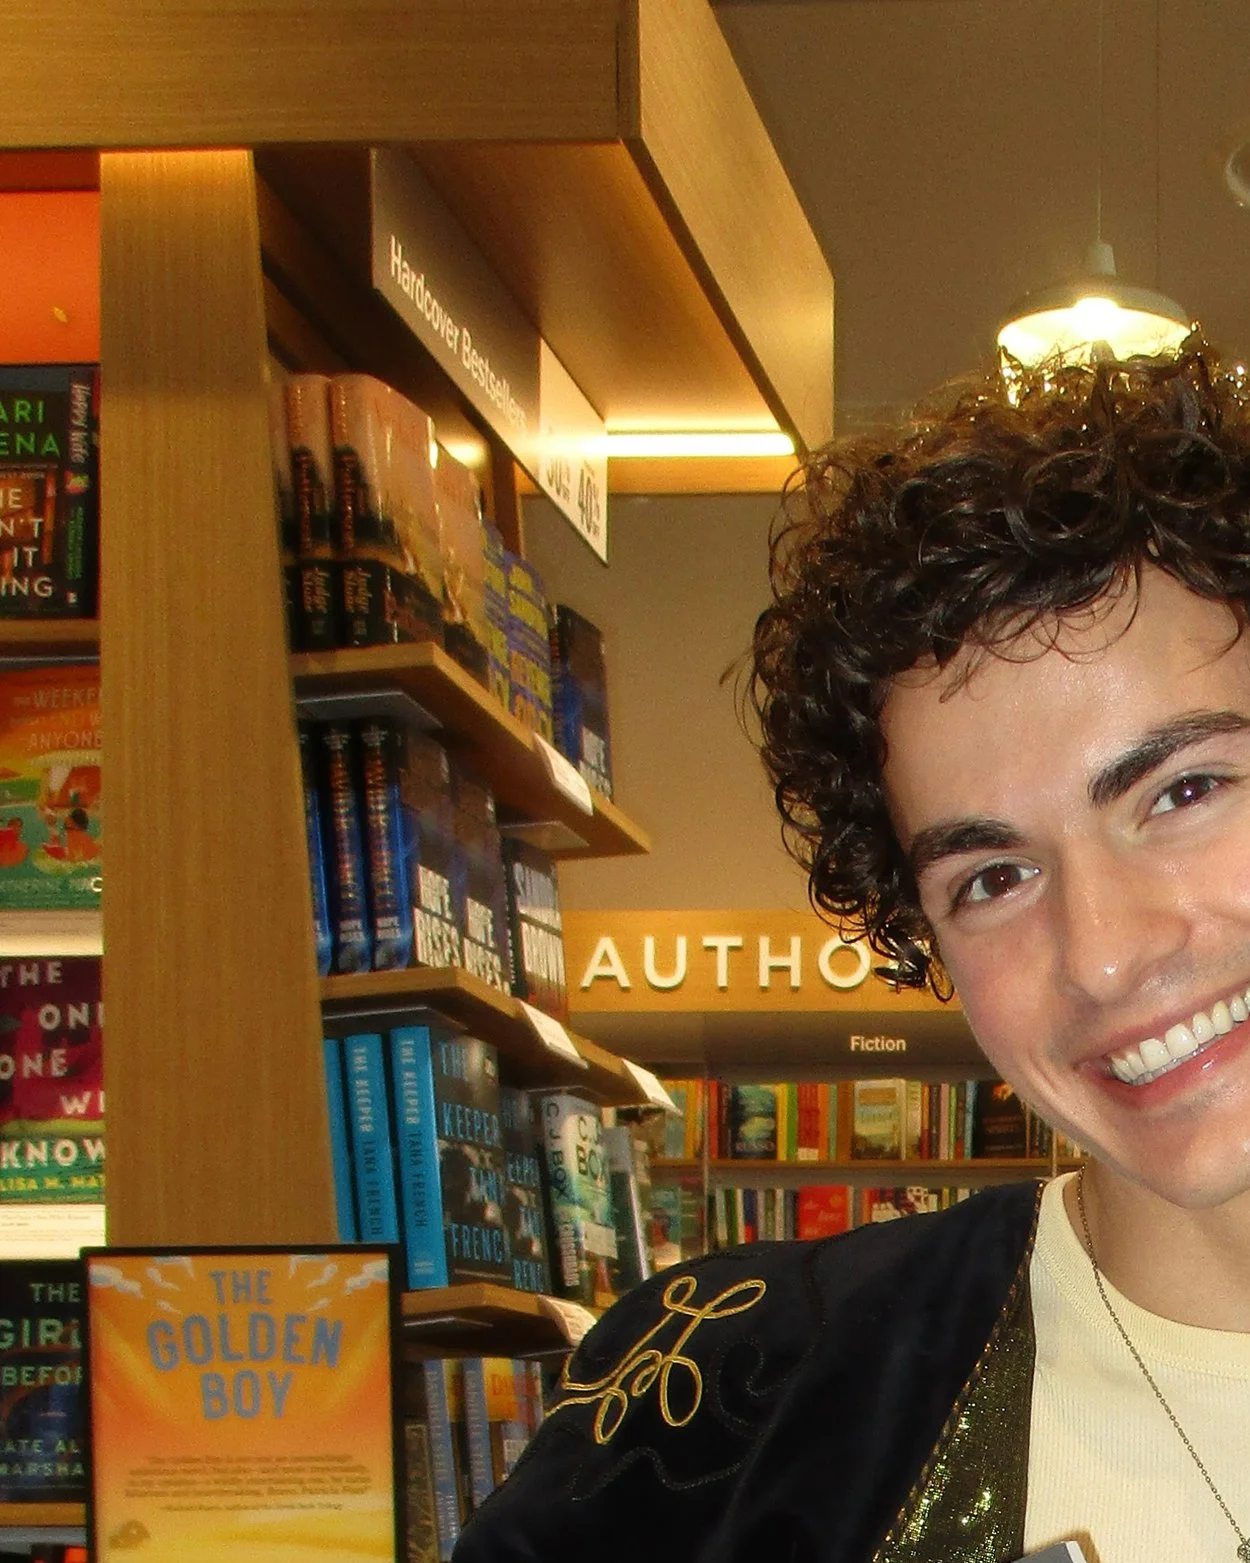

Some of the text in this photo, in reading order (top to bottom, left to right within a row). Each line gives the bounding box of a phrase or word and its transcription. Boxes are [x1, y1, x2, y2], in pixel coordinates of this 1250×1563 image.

[389, 235, 460, 353] Hardcover
[581, 935, 873, 989] AUTHO
[353, 1046, 368, 1073] THE
[850, 1035, 907, 1052] Fiction
[355, 1079, 375, 1133] KEEPER
[399, 1039, 421, 1126] THE KEEPER
[29, 1283, 81, 1303] THE
[209, 1270, 272, 1307] THE
[146, 1312, 344, 1373] GOLDEN
[201, 1370, 297, 1422] BOY
